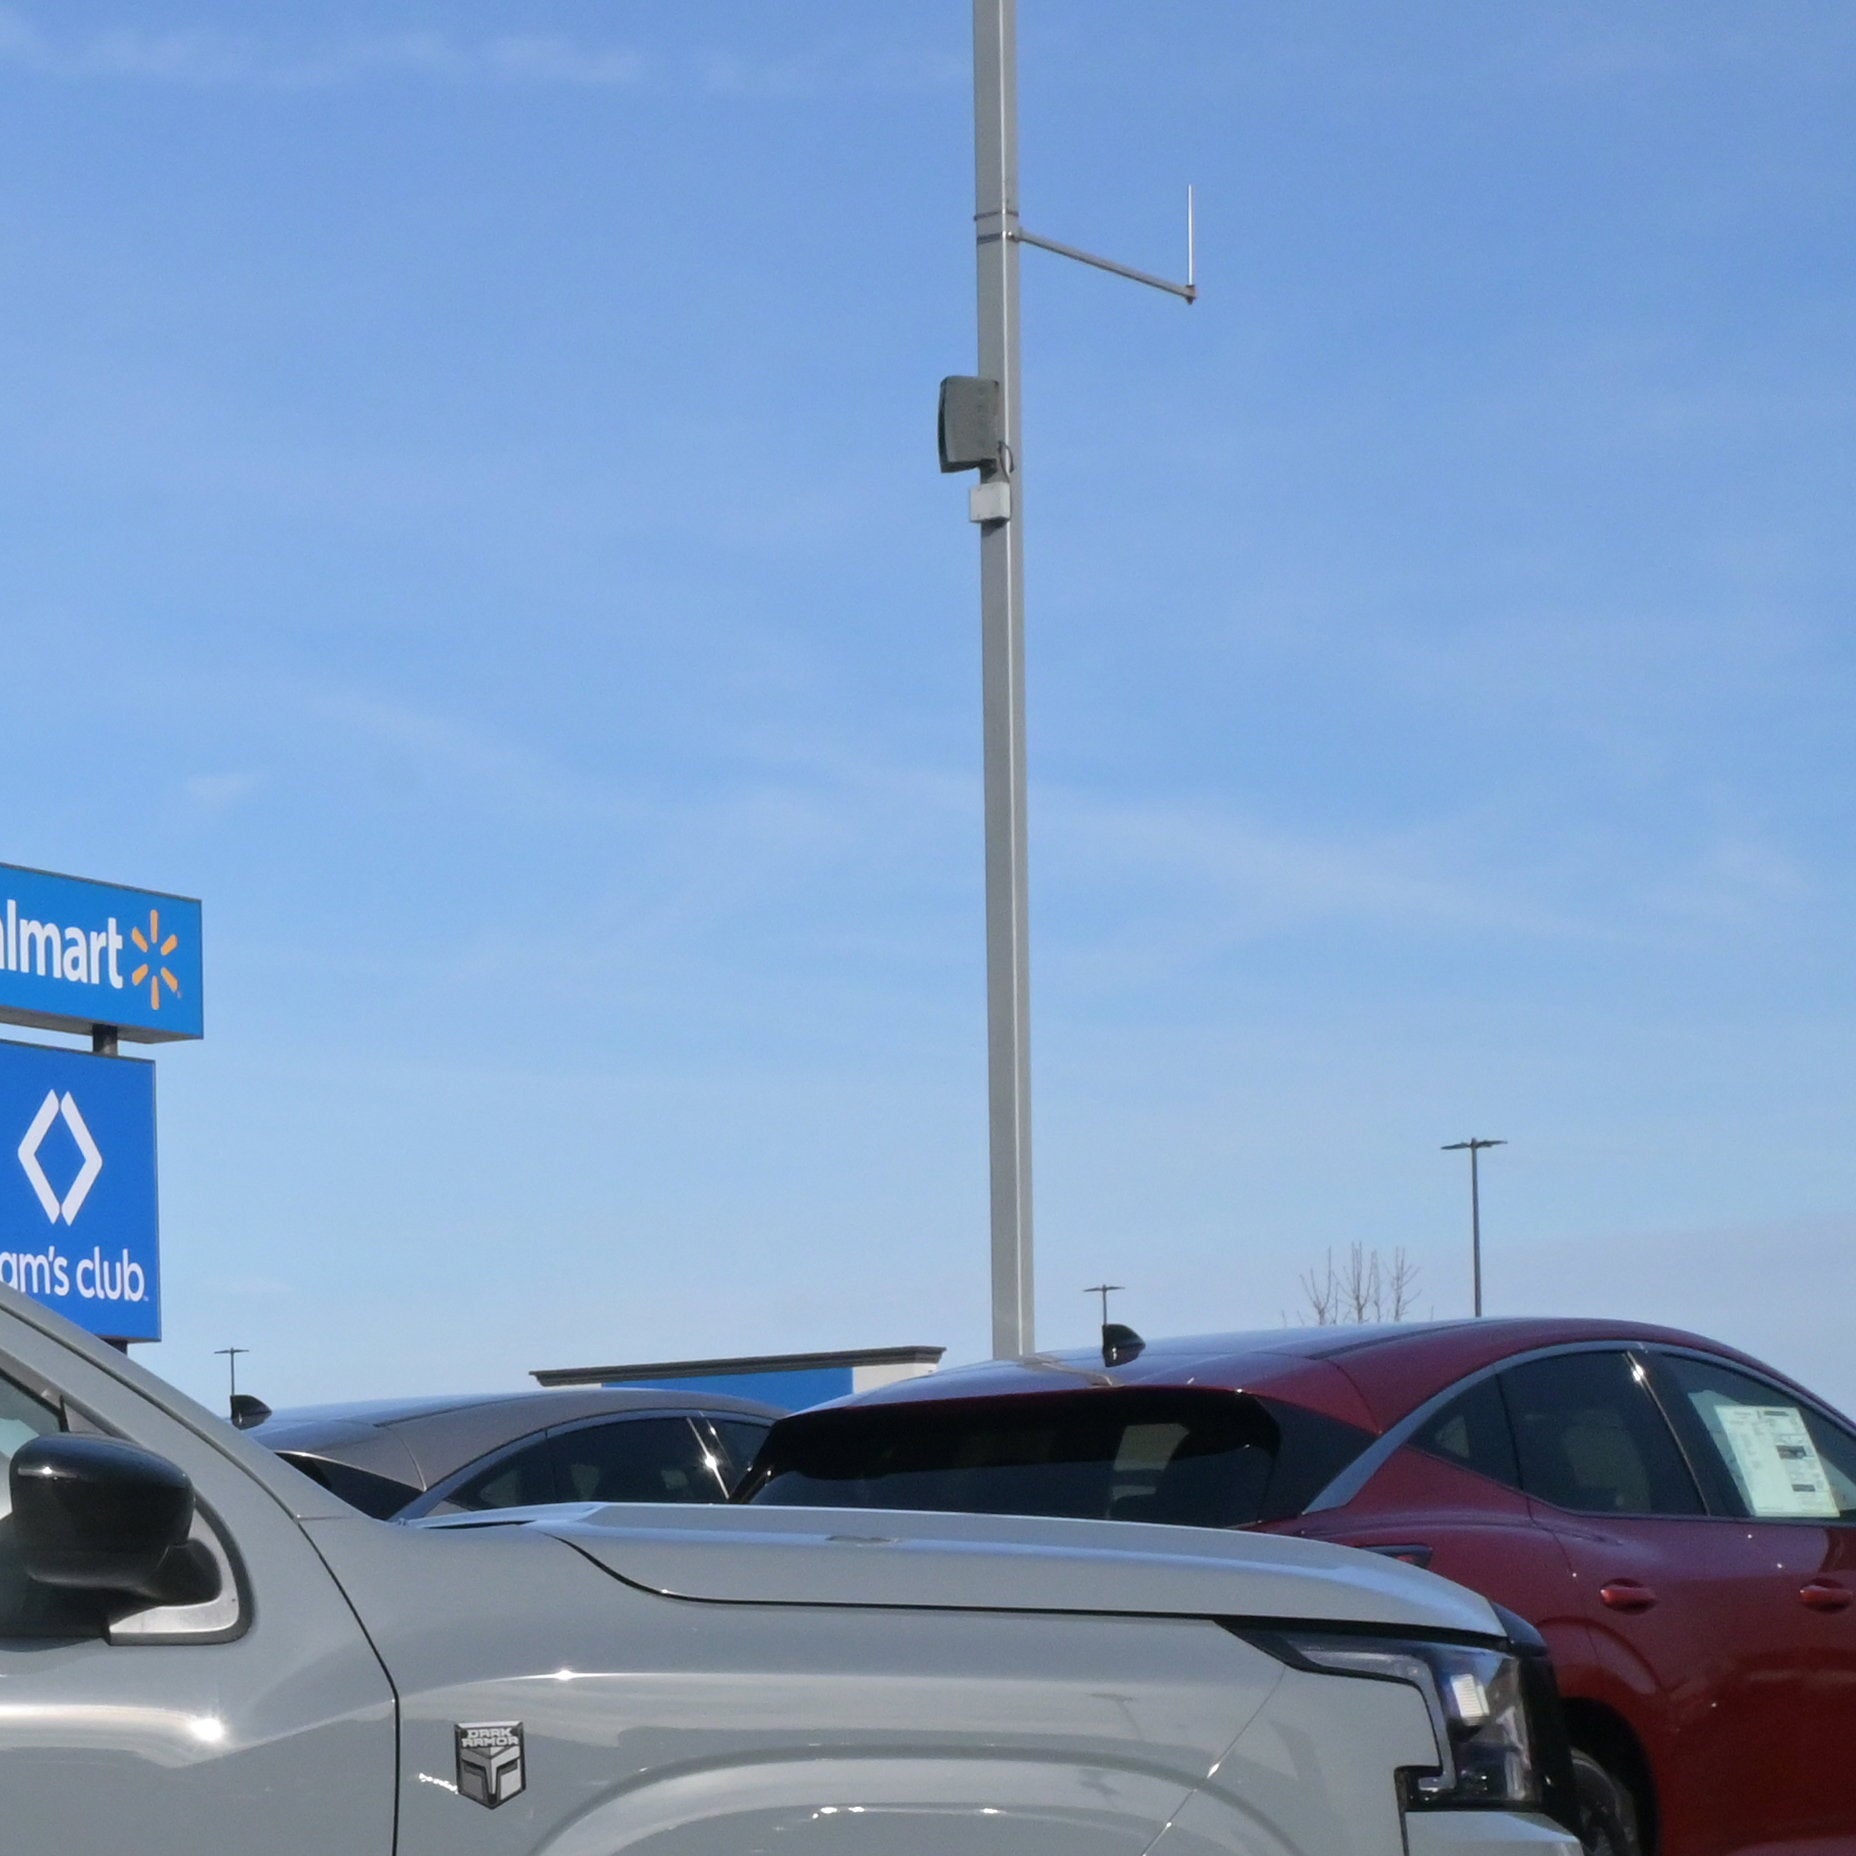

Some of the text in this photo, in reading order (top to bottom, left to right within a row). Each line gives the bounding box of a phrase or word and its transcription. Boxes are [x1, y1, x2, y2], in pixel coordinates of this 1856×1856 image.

[76, 1245, 145, 1302] club
[467, 1728, 512, 1739] DARK
[461, 1736, 519, 1747] ARMOR
